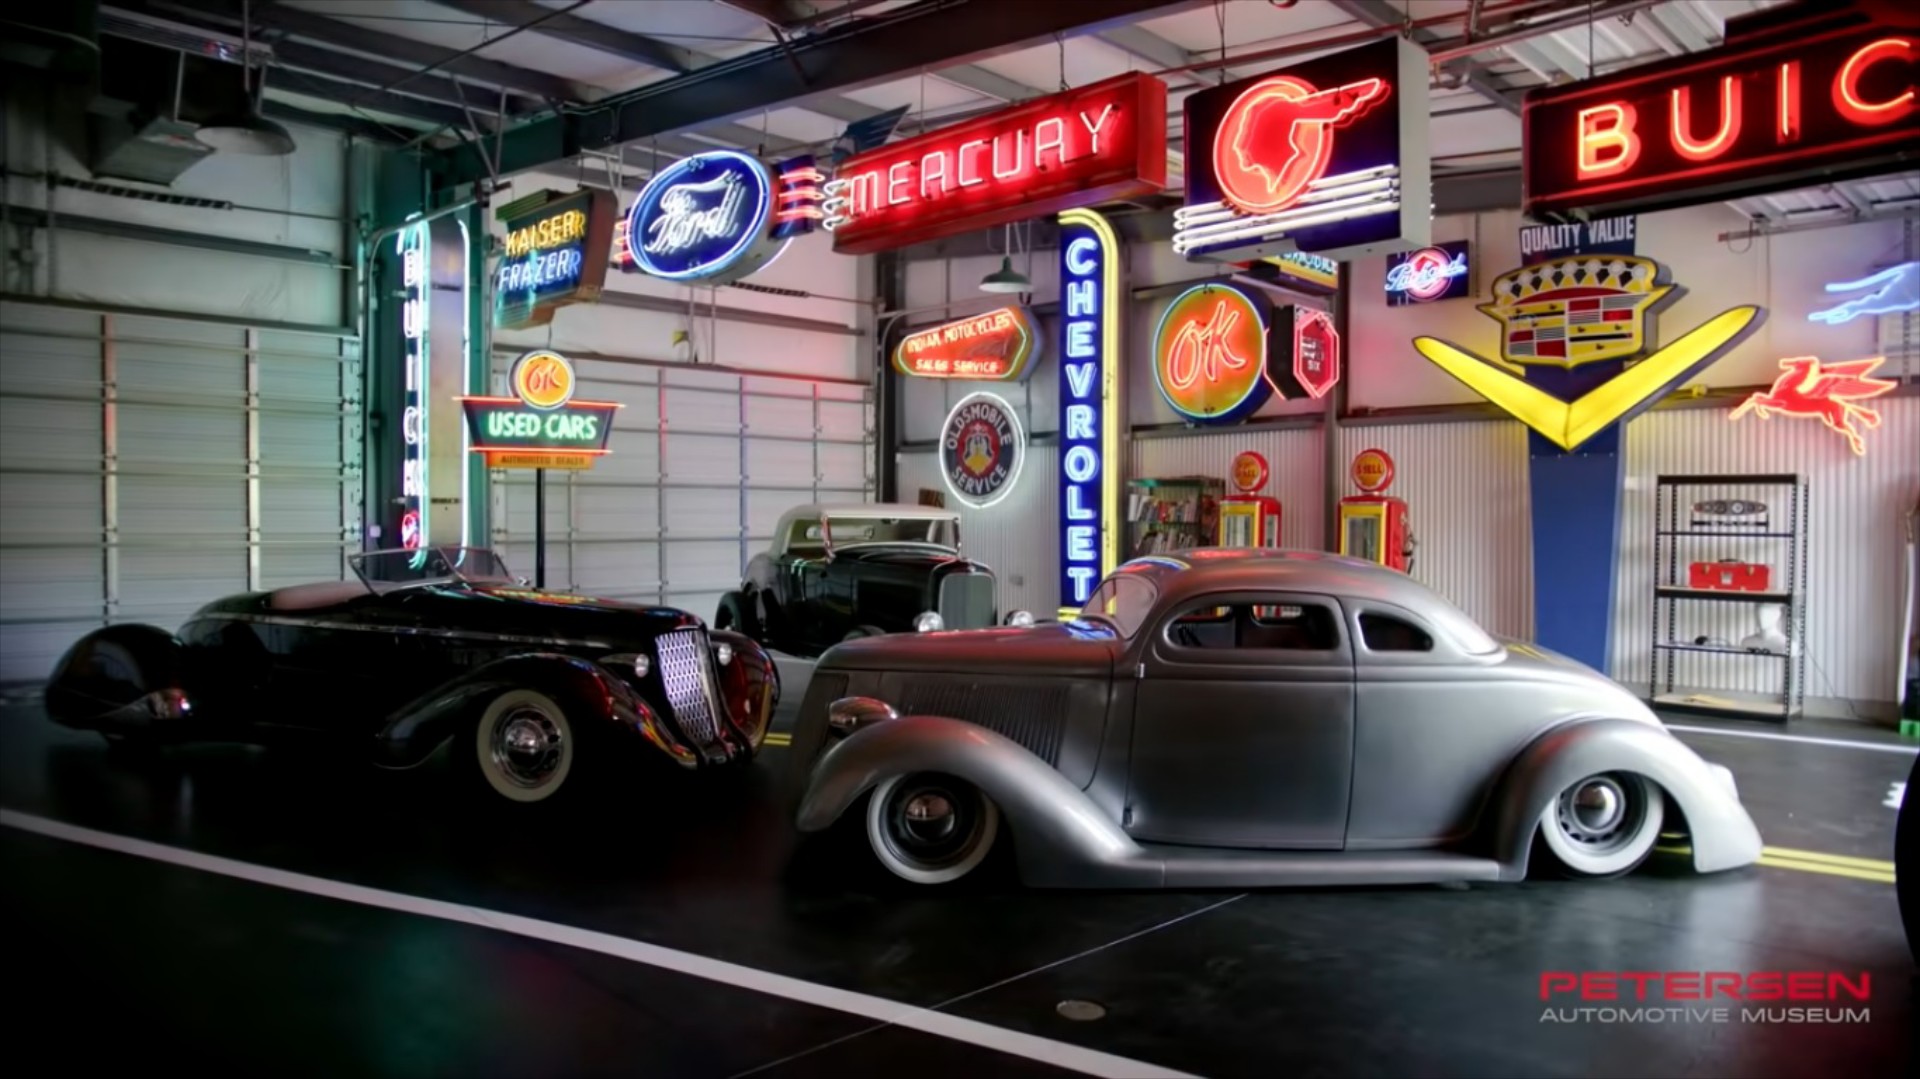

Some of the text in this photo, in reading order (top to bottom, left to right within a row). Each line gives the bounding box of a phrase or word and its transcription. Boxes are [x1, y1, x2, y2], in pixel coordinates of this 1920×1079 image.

[849, 102, 1118, 213] MERCURY
[505, 209, 586, 257] KAISER
[644, 168, 744, 256] Ford
[1521, 214, 1635, 255] QUALITY VALUE
[498, 248, 581, 291] FRAZER
[915, 358, 998, 373] SALES SERVICE
[1166, 299, 1247, 392] OK
[525, 362, 563, 396] OK
[488, 411, 598, 440] USED CARS
[946, 403, 1013, 450] OLDSMOBILE
[1064, 236, 1100, 602] CHEVROLET
[951, 463, 1007, 495] SERVICE
